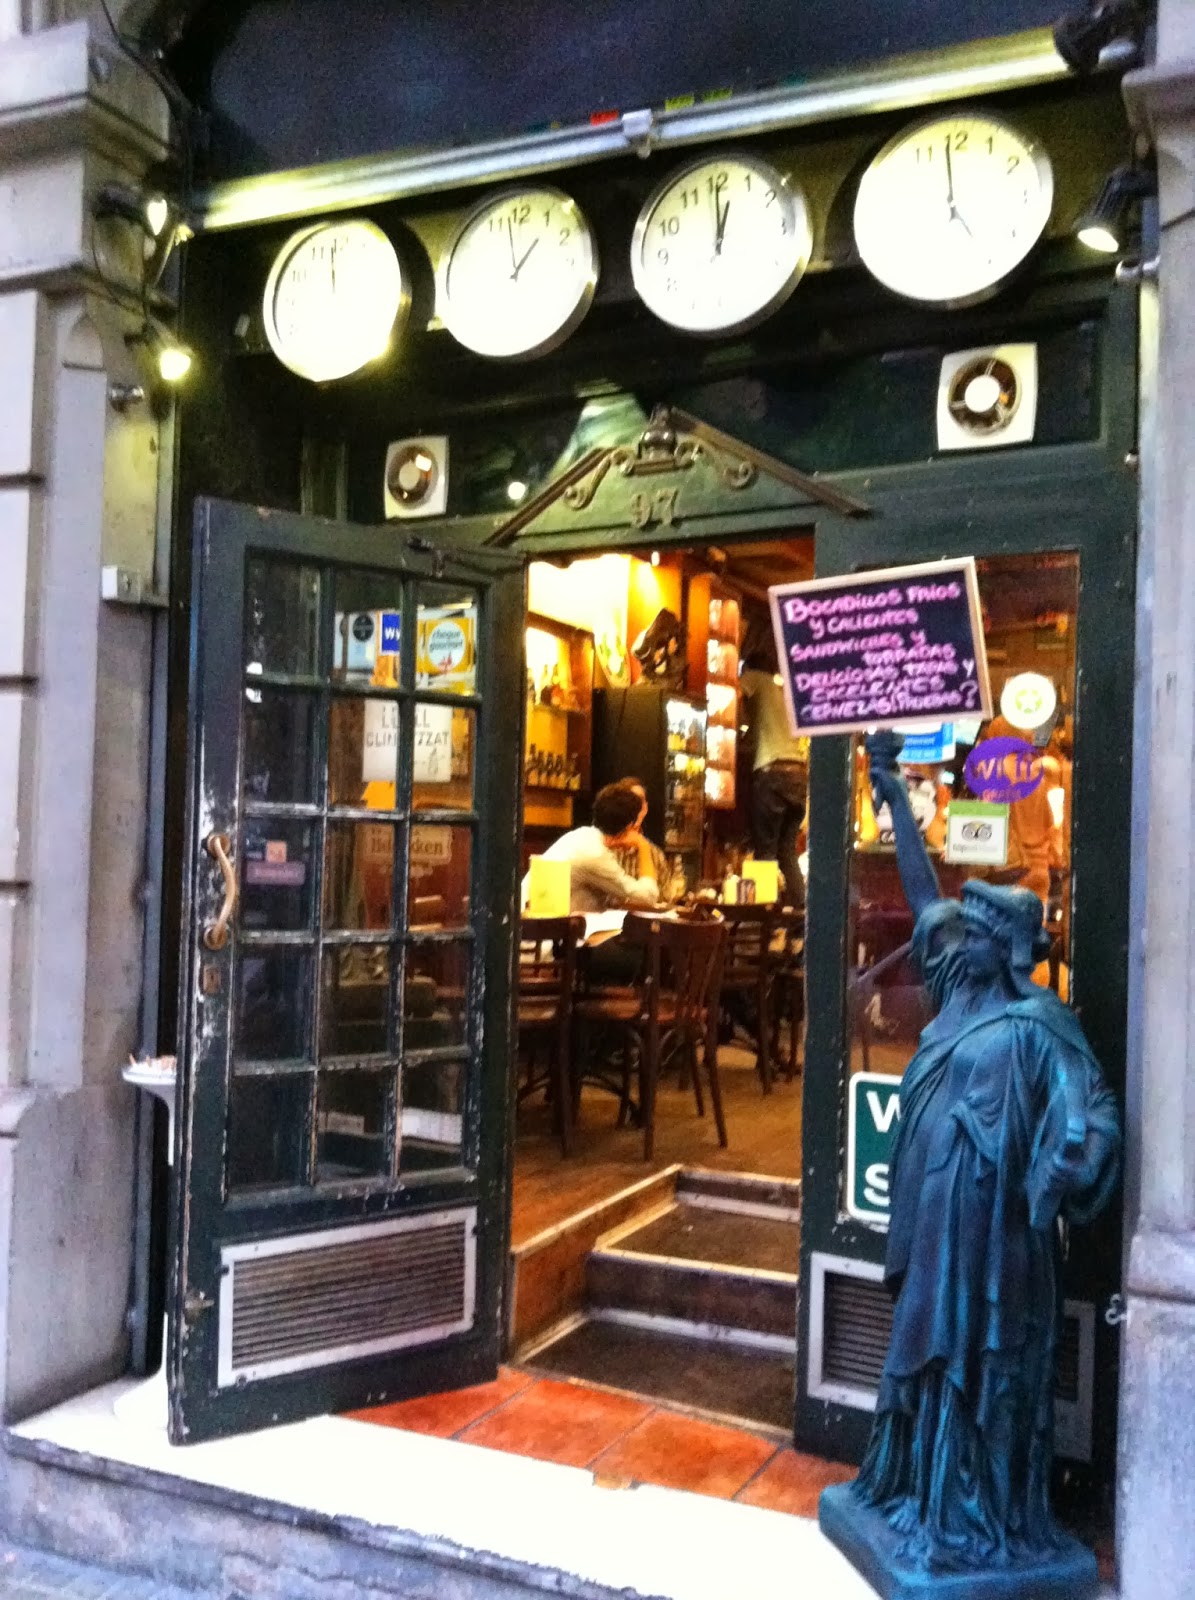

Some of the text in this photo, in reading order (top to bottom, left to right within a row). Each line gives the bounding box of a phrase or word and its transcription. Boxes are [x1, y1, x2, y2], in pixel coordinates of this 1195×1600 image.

[706, 171, 729, 195] 12
[680, 187, 699, 209] 11
[512, 204, 532, 227] 12
[659, 216, 680, 237] 10
[657, 247, 669, 266] 9
